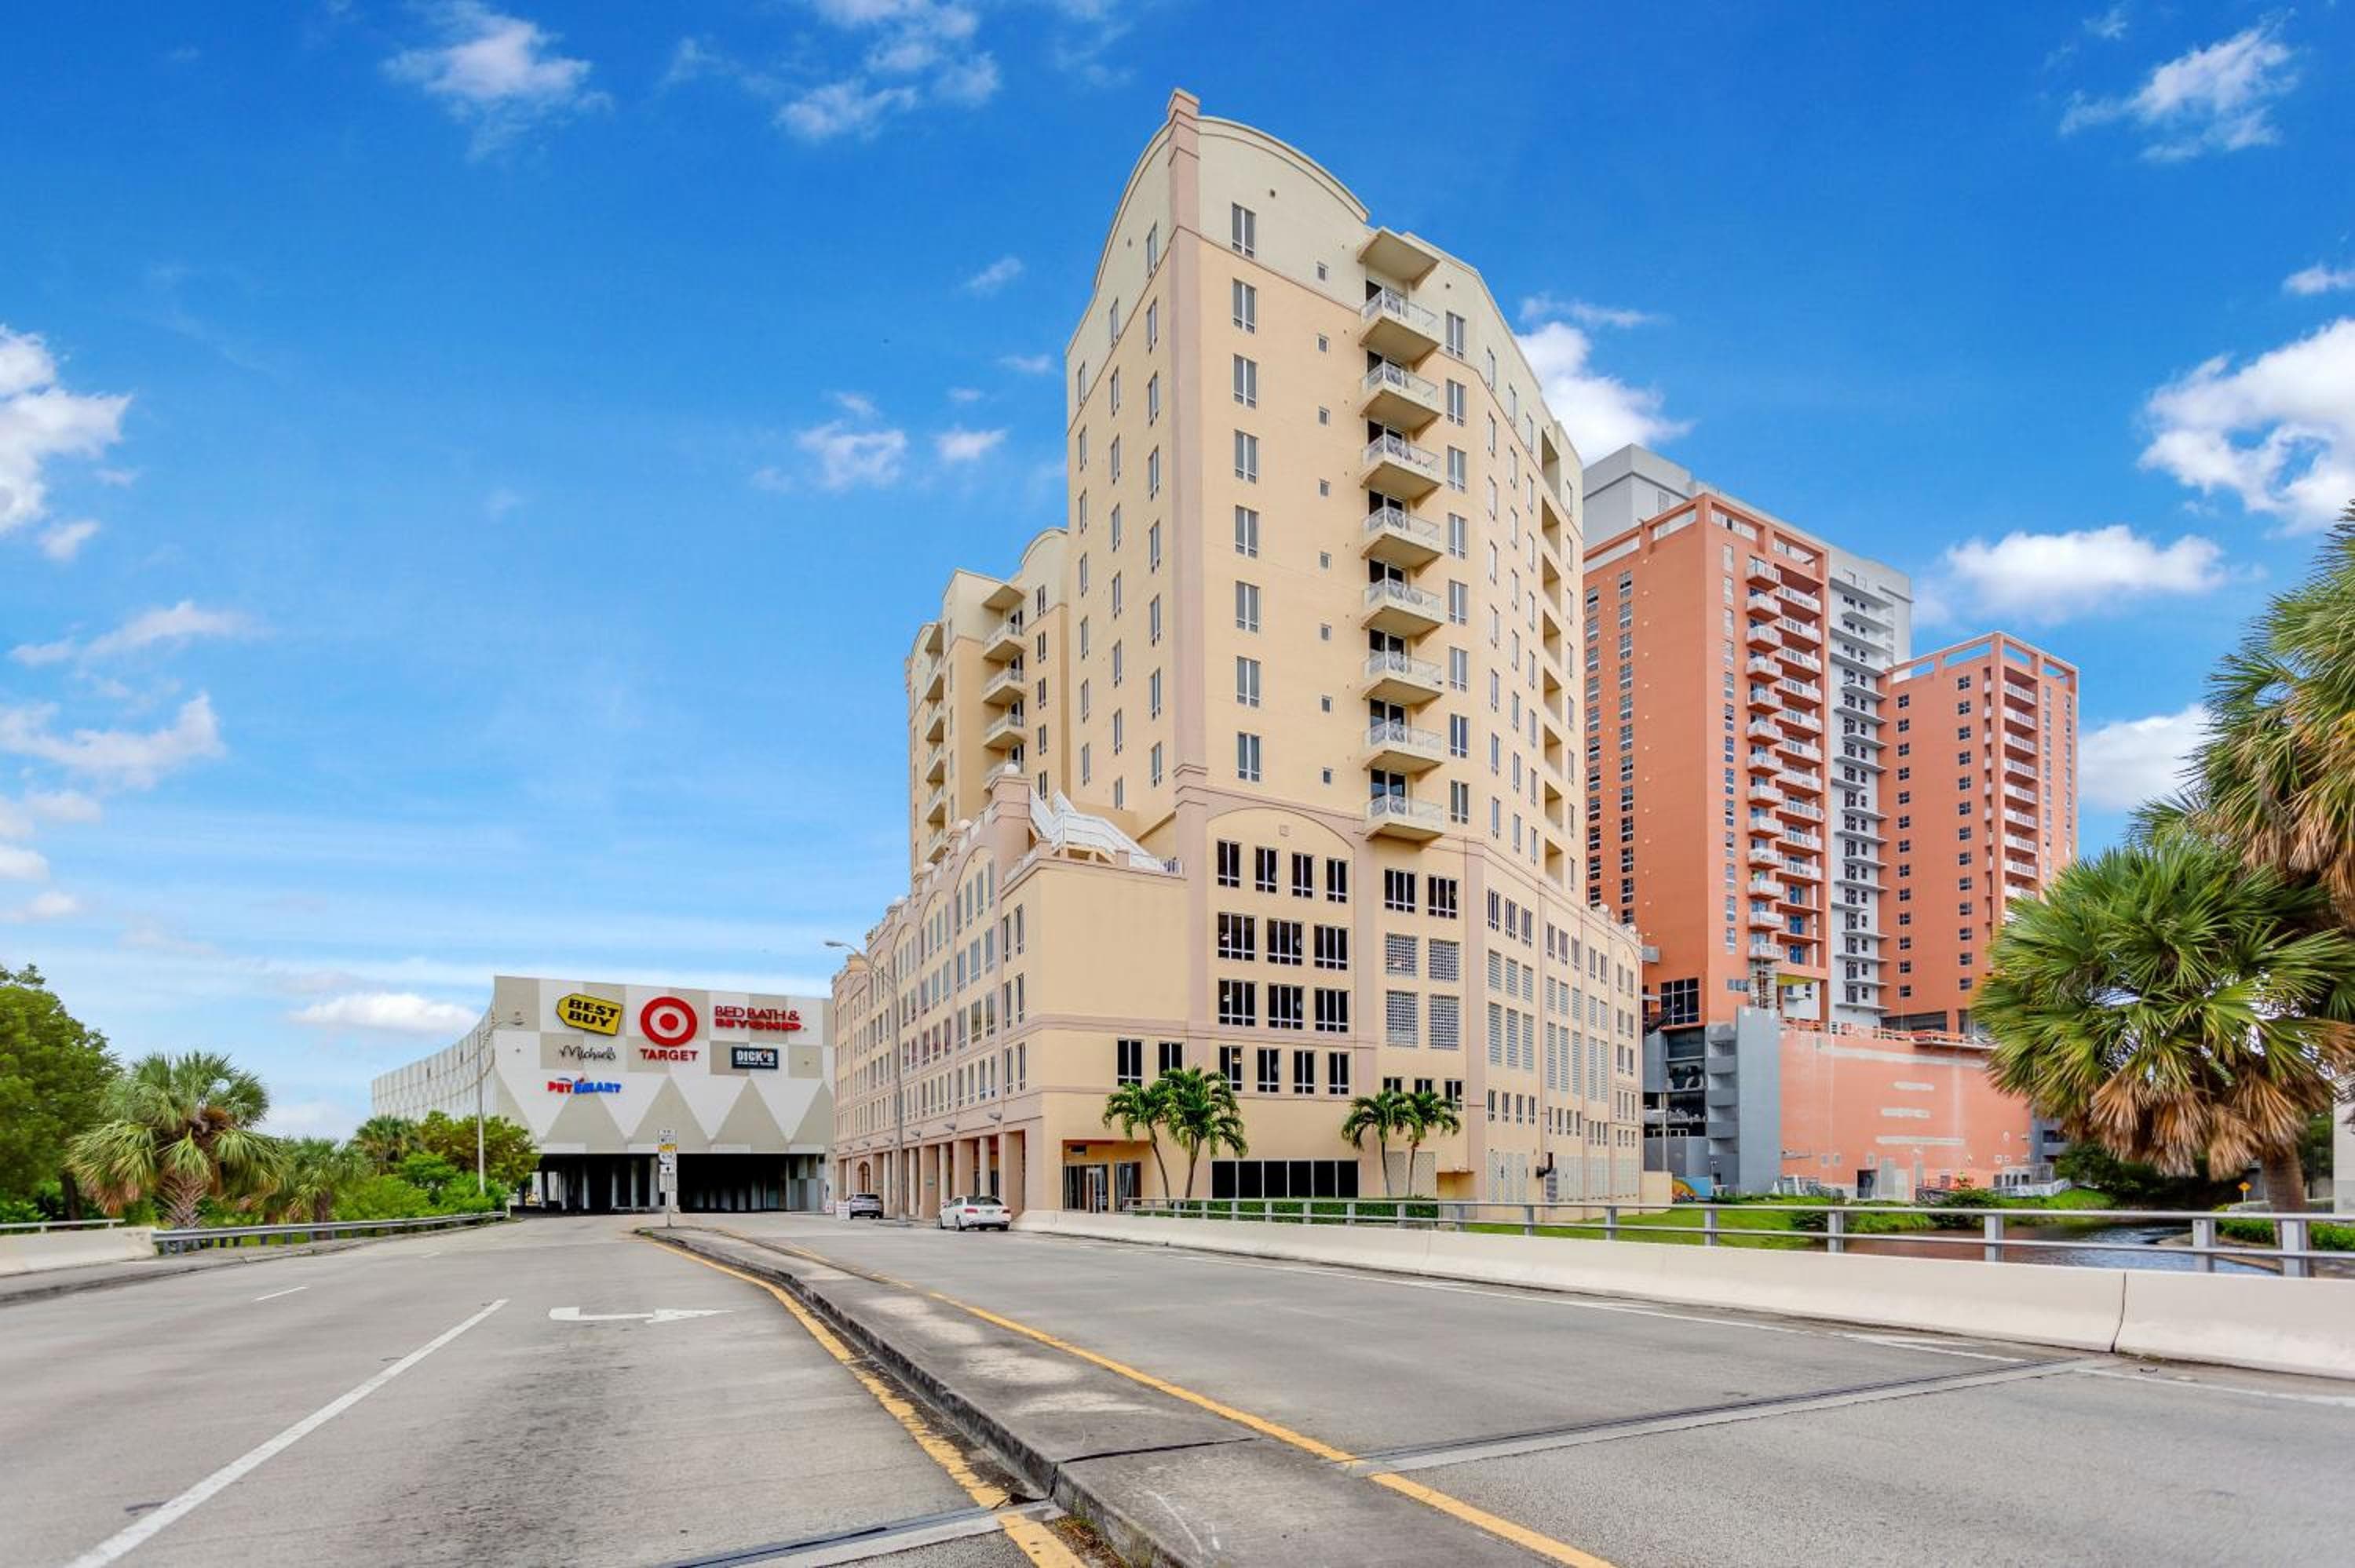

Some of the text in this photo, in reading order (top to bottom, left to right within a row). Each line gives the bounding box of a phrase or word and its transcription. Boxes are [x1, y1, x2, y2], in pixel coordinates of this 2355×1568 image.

[568, 998, 619, 1018] BEST
[715, 1005, 800, 1021] BED BATH &
[568, 1010, 612, 1027] BUY
[559, 1045, 616, 1060] Michaels
[640, 1048, 699, 1061] TARGET
[736, 1050, 775, 1062] DICK'S
